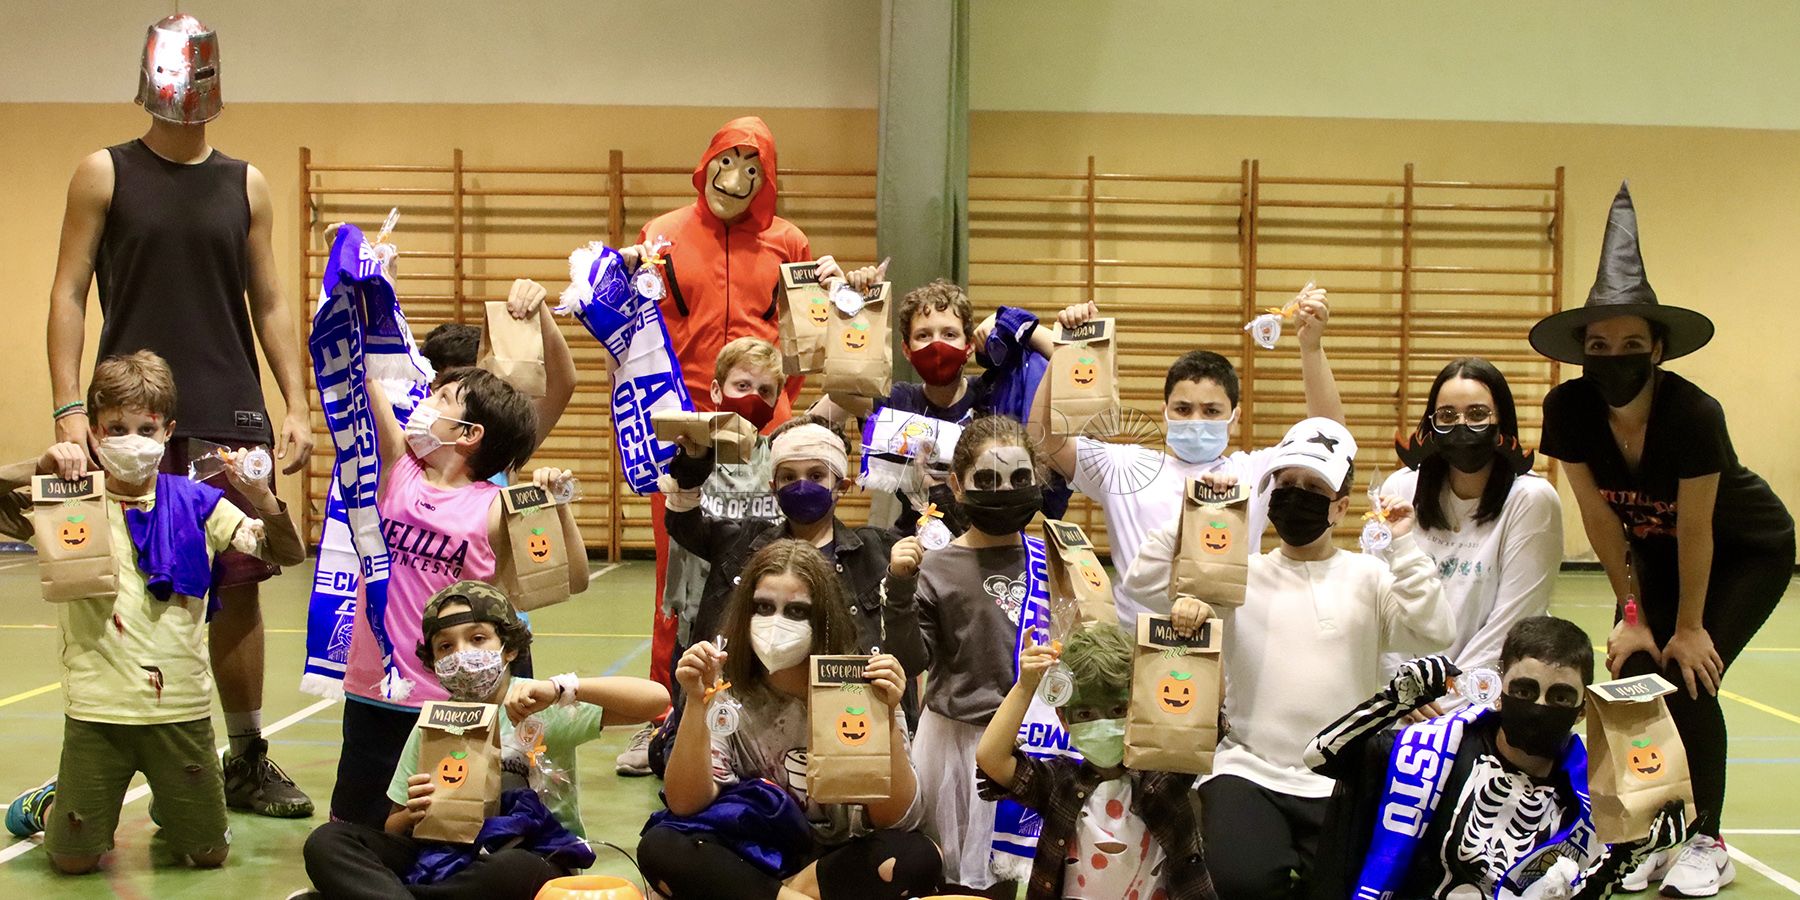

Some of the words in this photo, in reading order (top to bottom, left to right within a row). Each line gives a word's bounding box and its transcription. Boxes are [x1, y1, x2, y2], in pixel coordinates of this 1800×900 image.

[793, 268, 816, 281] ARTU
[47, 480, 88, 494] JAVIER
[391, 551, 462, 579] ONCESTO
[820, 664, 864, 679] ESPERAN
[432, 709, 482, 723] MARCOS
[1383, 722, 1448, 837] ESTO
